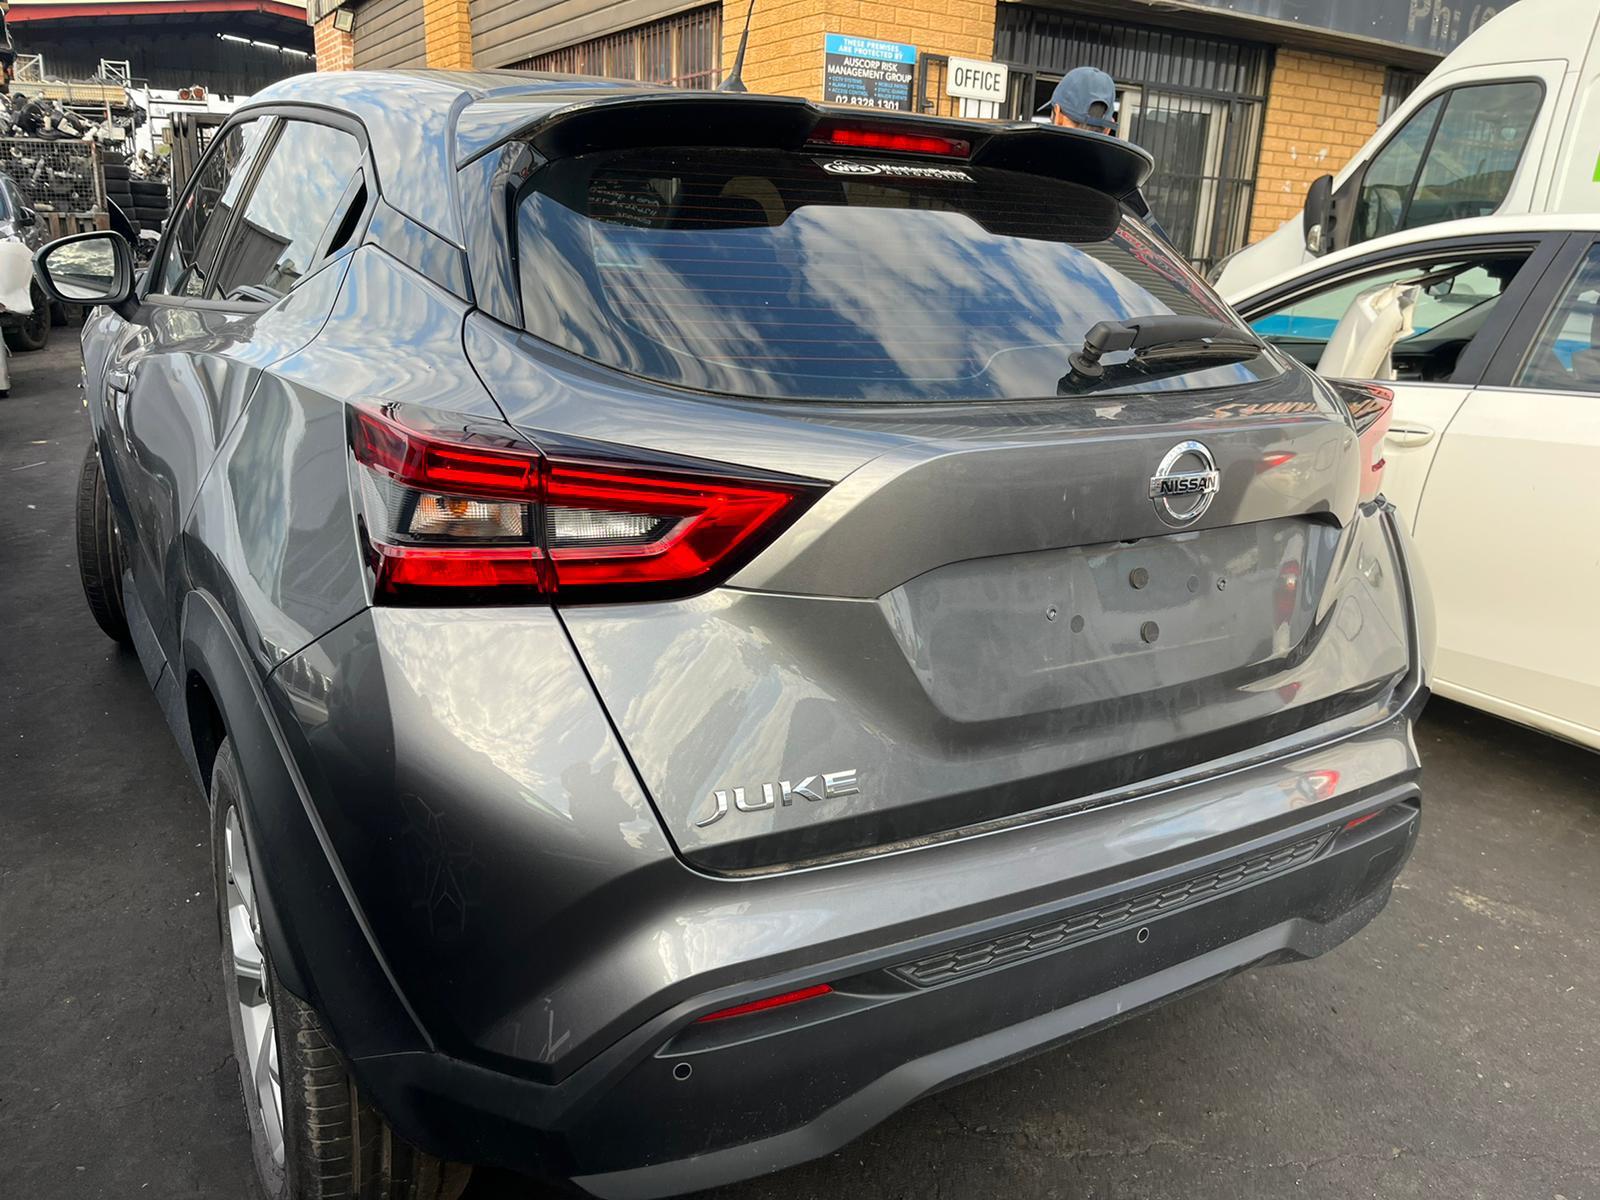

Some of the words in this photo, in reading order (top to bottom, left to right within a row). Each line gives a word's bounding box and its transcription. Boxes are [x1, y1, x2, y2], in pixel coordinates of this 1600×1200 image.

[1407, 0, 1461, 41] Ph:
[838, 44, 852, 53] ARE
[853, 47, 893, 58] PROTECTED
[894, 51, 904, 60] BY
[843, 38, 865, 47] THESE
[866, 41, 899, 52] PREMISES
[843, 56, 881, 69] AUSCORP
[881, 61, 898, 72] RISK
[827, 64, 885, 80] MANAGEMENT
[885, 71, 912, 83] GROUP
[954, 66, 1002, 92] OFFICE
[835, 95, 849, 104] 02
[1160, 476, 1216, 493] NISSAN
[695, 769, 860, 828] JUKE
